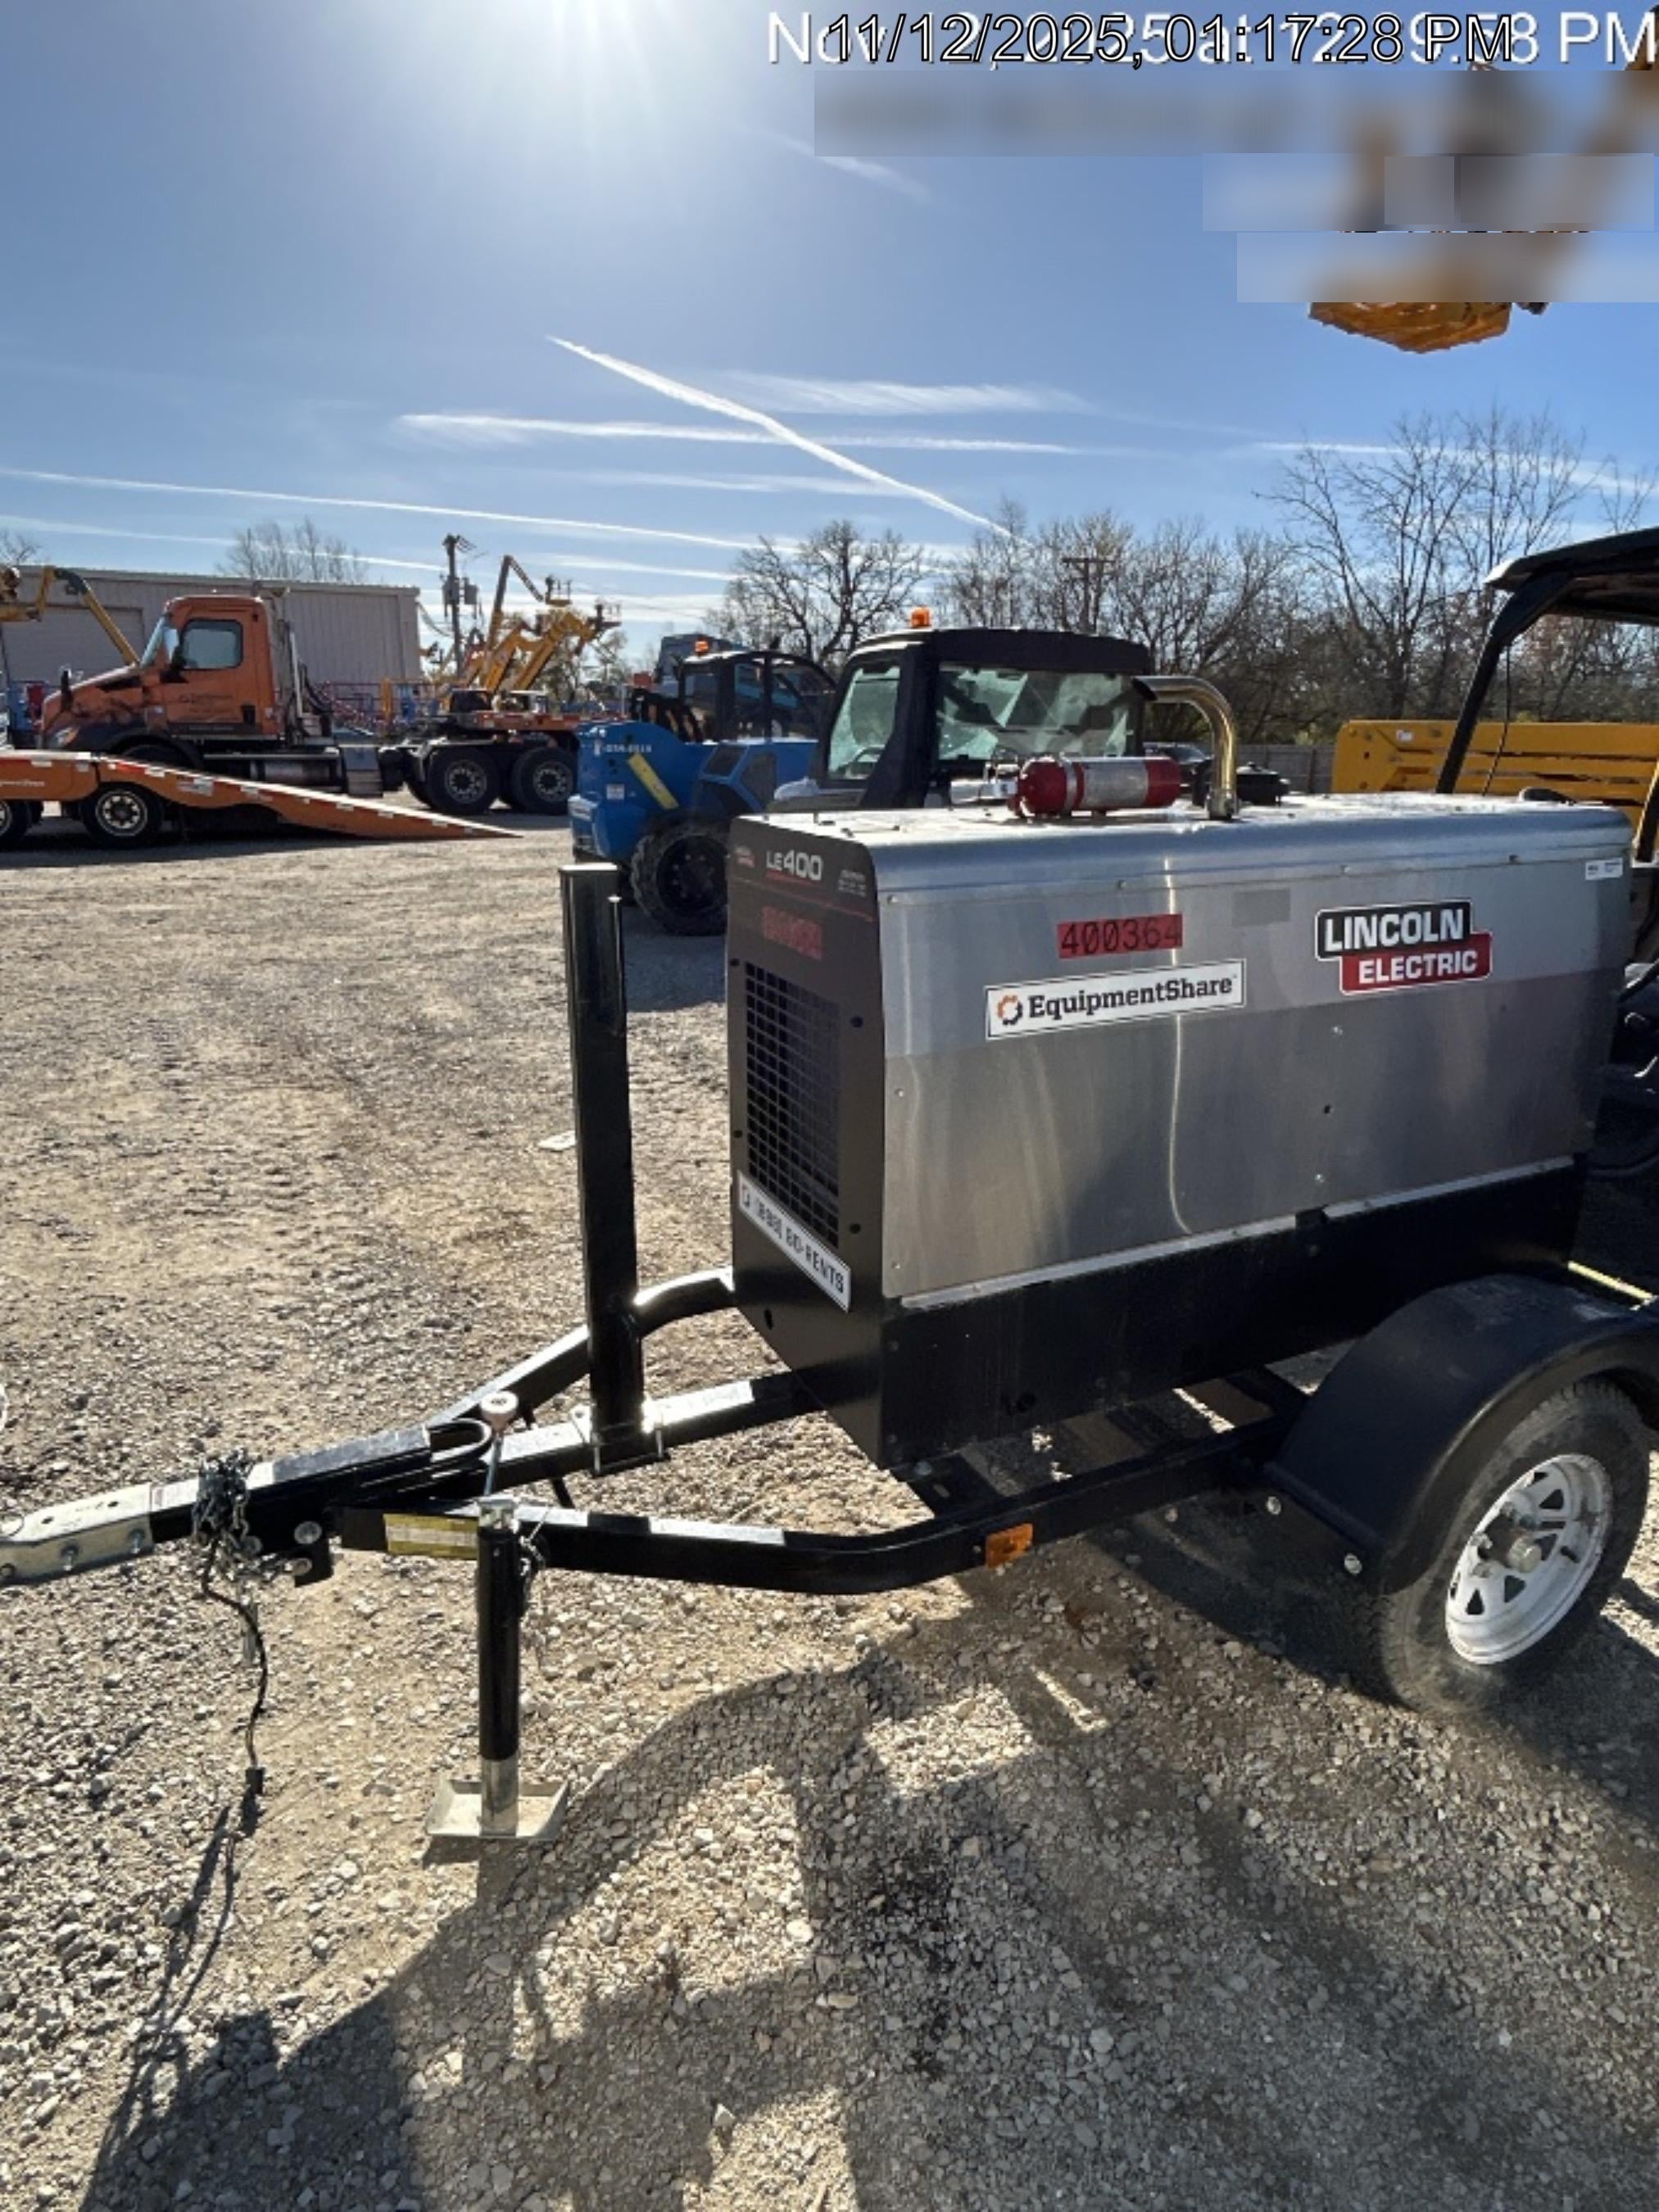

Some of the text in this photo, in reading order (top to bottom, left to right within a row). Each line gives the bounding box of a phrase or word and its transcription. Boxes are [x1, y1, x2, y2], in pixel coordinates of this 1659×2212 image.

[1060, 915, 1181, 955] 400364
[1324, 908, 1464, 952] LINCOLN
[1358, 950, 1478, 985] ELECTRIC
[1027, 976, 1234, 1021] EquipmentShare
